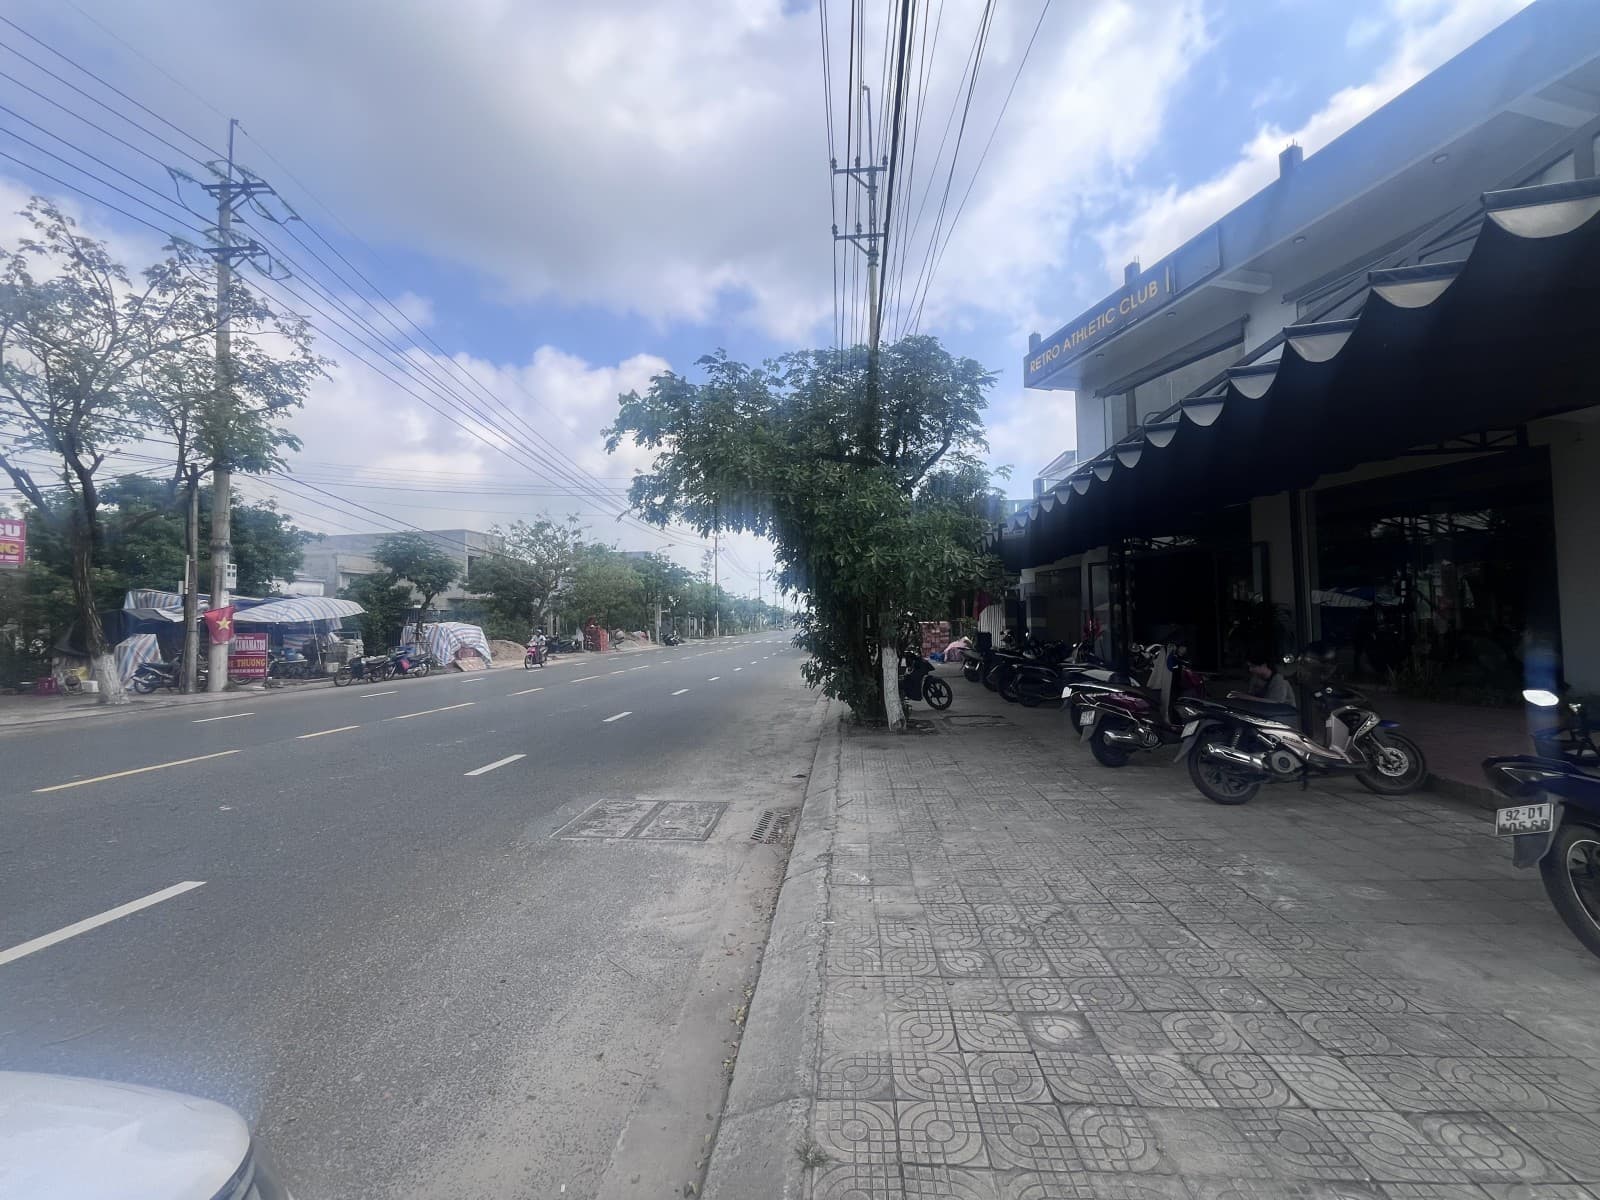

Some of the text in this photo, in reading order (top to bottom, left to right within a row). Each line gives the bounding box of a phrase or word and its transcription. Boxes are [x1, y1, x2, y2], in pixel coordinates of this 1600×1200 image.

[1030, 280, 1158, 374] RETRO ATHLETIC CLUB
